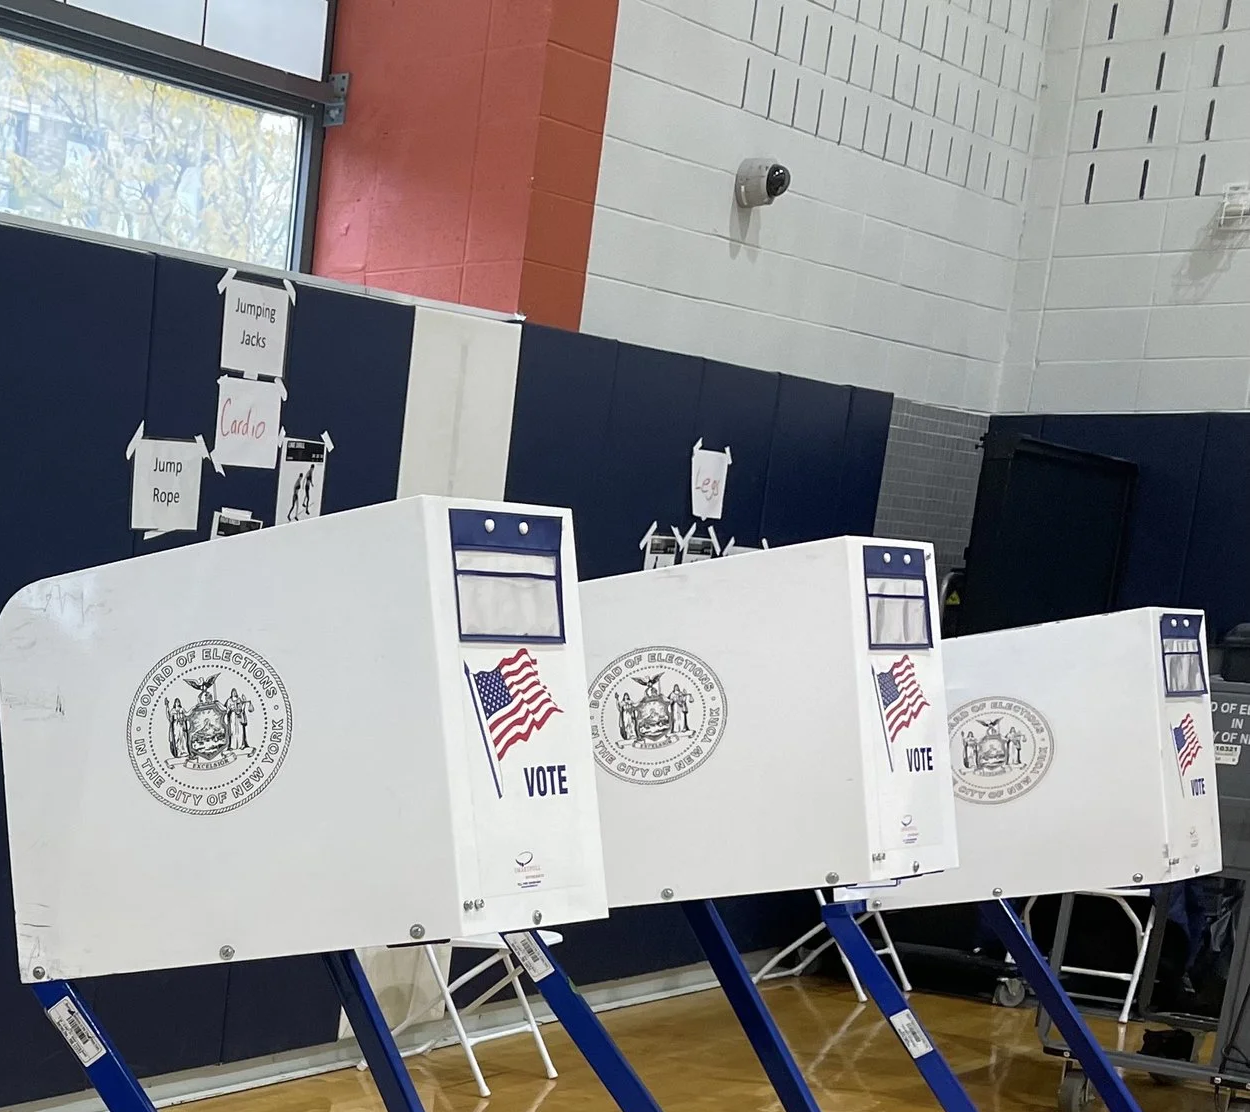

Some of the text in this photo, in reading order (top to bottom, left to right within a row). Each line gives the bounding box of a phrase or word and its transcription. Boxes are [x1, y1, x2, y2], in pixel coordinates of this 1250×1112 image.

[235, 297, 277, 324] Jumping
[240, 329, 267, 350] Jacks
[220, 397, 266, 441] Cardio
[153, 457, 183, 475] Jump
[152, 487, 180, 507] Rope
[136, 648, 278, 718] BOARD OF ELECTIONS
[589, 652, 715, 709] BOARD OF ELECTIONS
[1221, 702, 1238, 714] OF
[1231, 718, 1244, 729] IN
[595, 739, 617, 765] THE
[616, 762, 650, 778] CITY
[652, 766, 671, 778] OF
[675, 745, 704, 771] NEW
[701, 707, 720, 743] YORK
[1221, 731, 1238, 743] OF
[134, 718, 284, 806] IN THE CITY OF NEW YORK
[905, 747, 933, 773] VOTE
[523, 764, 569, 798] VOTE
[1190, 777, 1206, 797] VOTE
